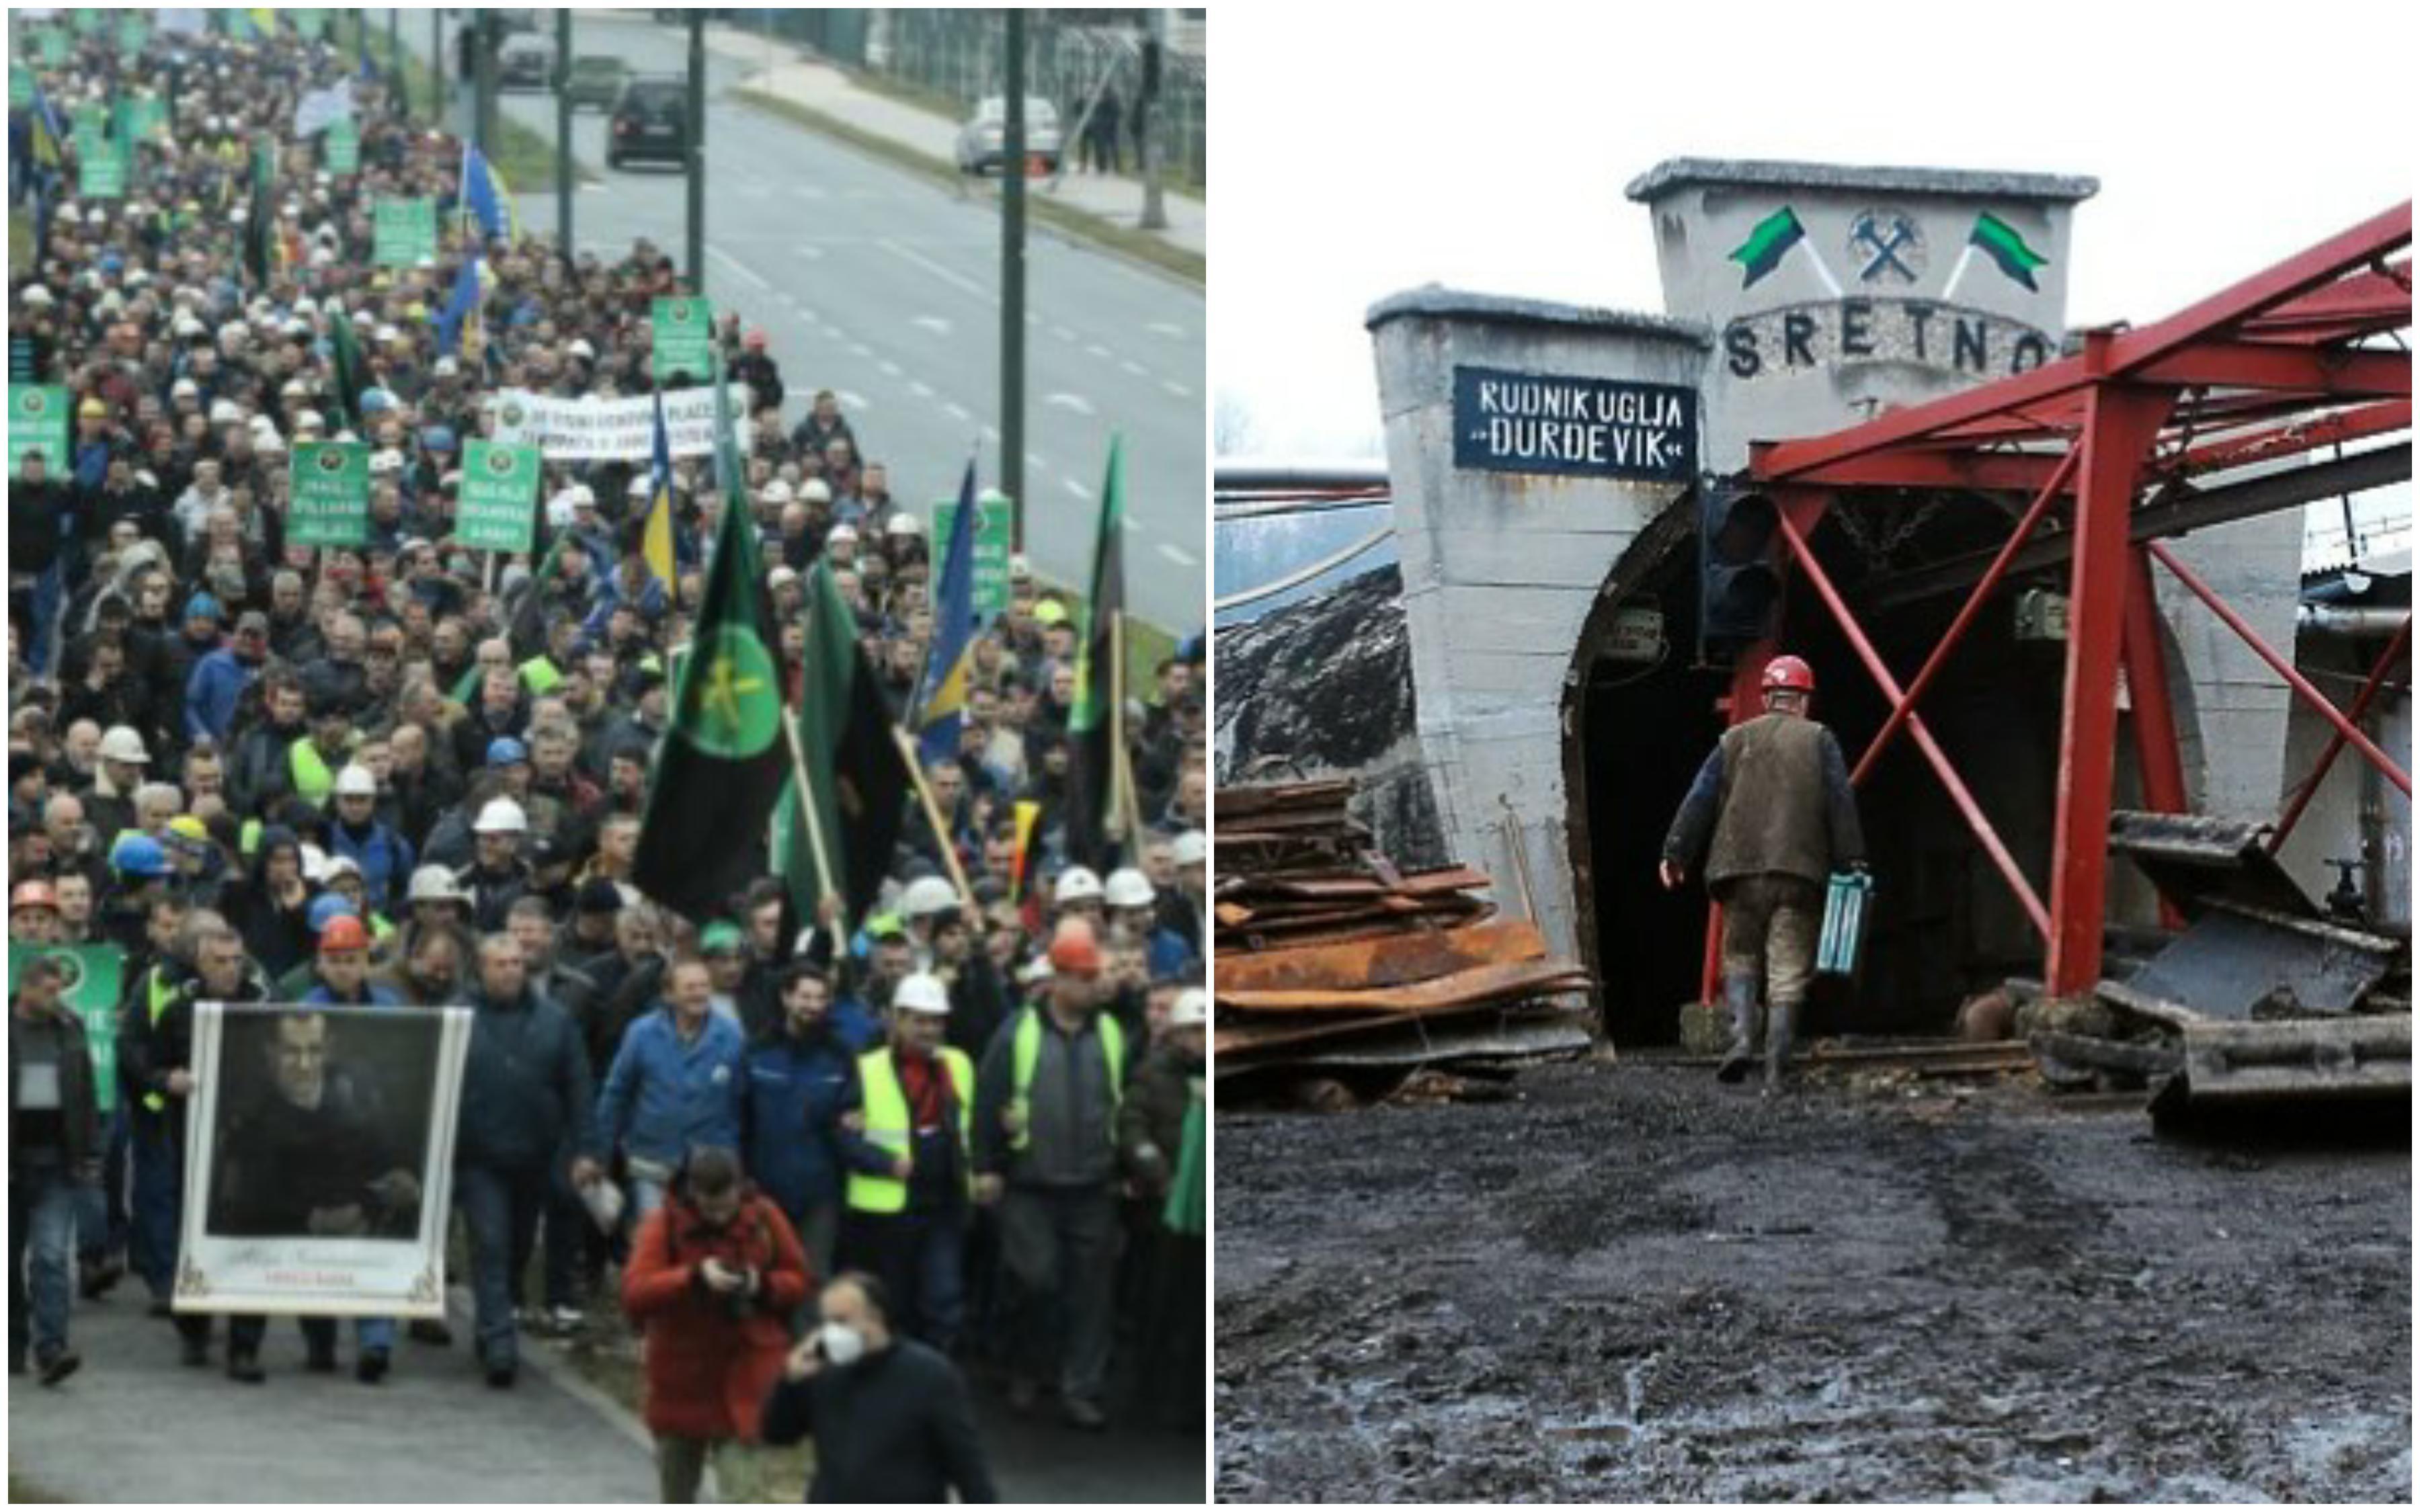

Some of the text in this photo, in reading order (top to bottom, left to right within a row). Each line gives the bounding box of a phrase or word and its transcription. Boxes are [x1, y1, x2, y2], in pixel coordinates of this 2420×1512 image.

[1726, 297, 2044, 379] SRETNO
[1480, 380, 1683, 429] RUDNIK UGLJA
